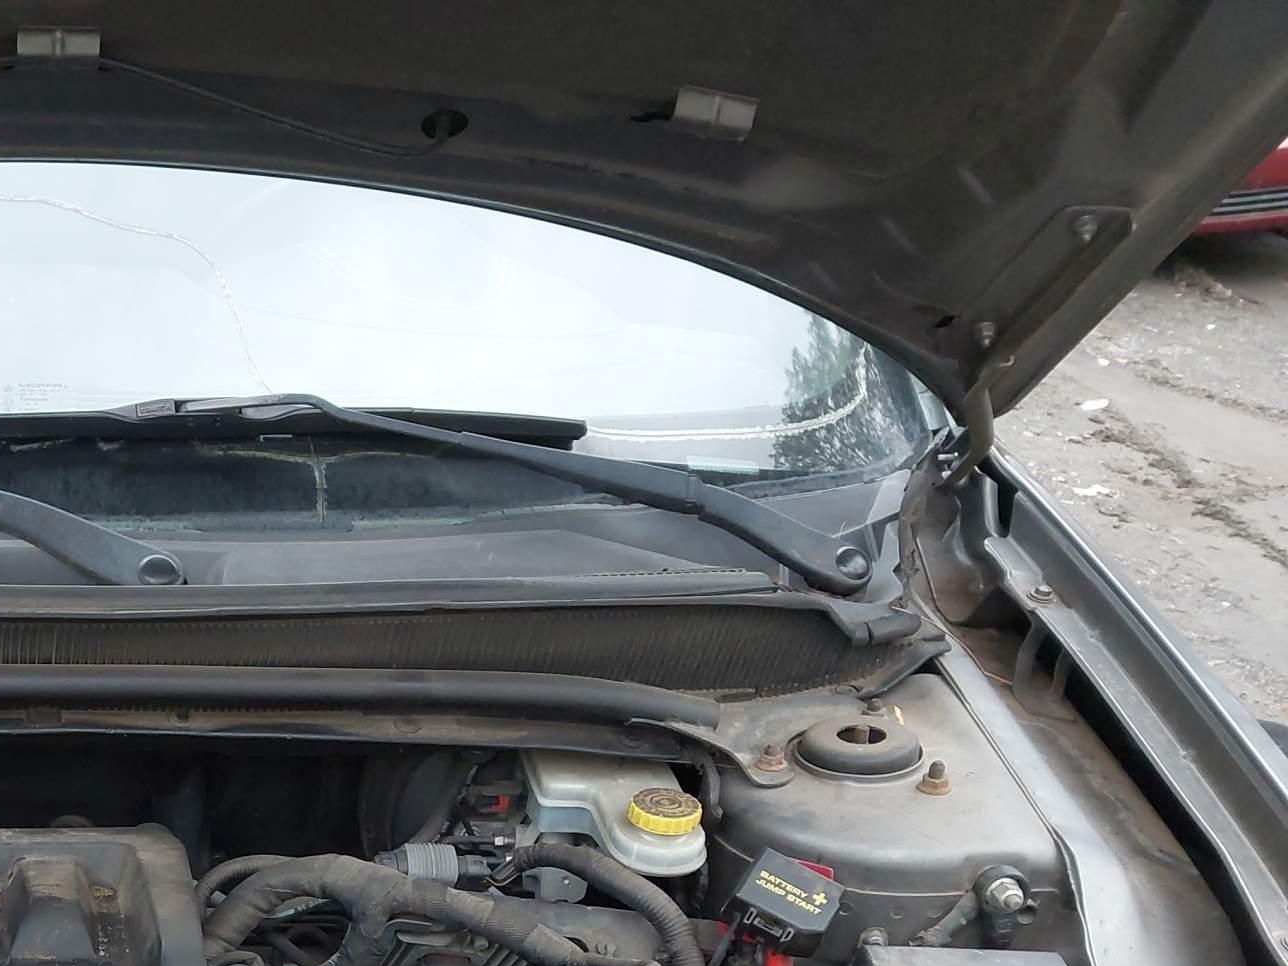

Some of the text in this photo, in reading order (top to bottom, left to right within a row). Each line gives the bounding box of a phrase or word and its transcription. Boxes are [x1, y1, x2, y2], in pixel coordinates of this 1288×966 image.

[755, 878, 823, 915] JUMP START
[759, 870, 809, 898] BATTERY
